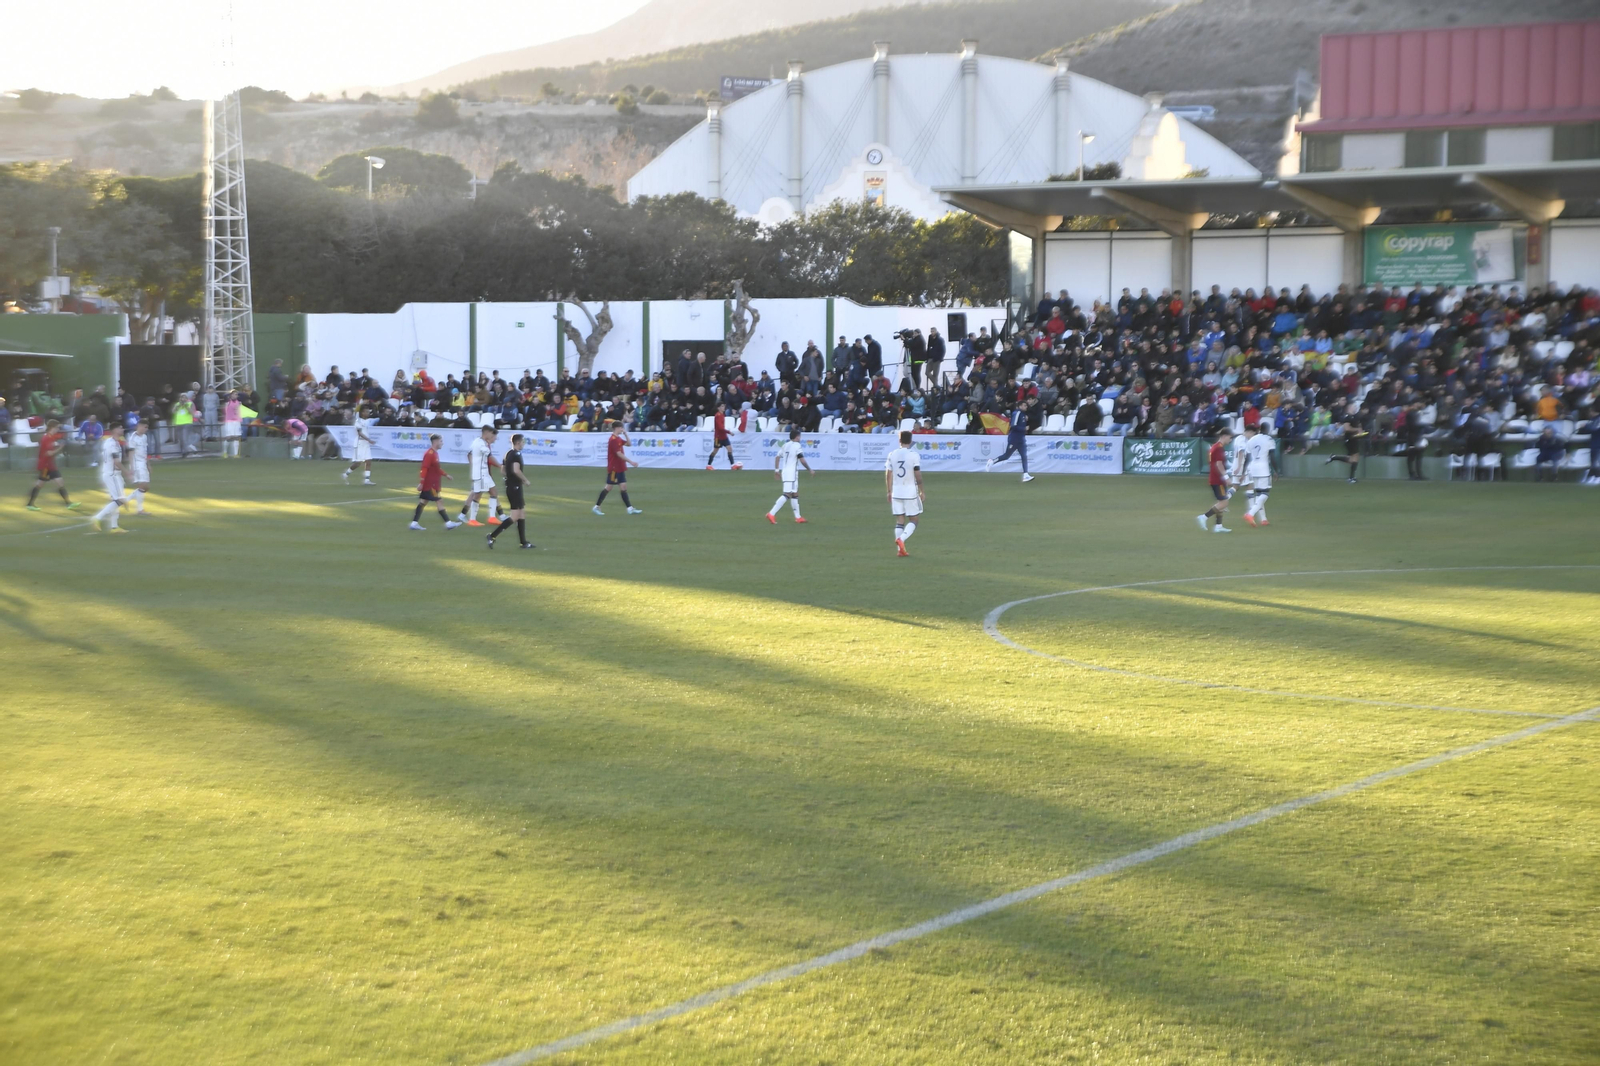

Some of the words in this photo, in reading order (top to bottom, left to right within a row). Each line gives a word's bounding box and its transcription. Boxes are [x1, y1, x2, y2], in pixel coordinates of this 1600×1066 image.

[1389, 235, 1455, 252] copyrap
[522, 448, 558, 456] REMOLINOS
[785, 451, 790, 465] 7
[1047, 453, 1113, 461] TORREMOLINOS
[1254, 445, 1261, 460] 2
[897, 461, 906, 478] 3
